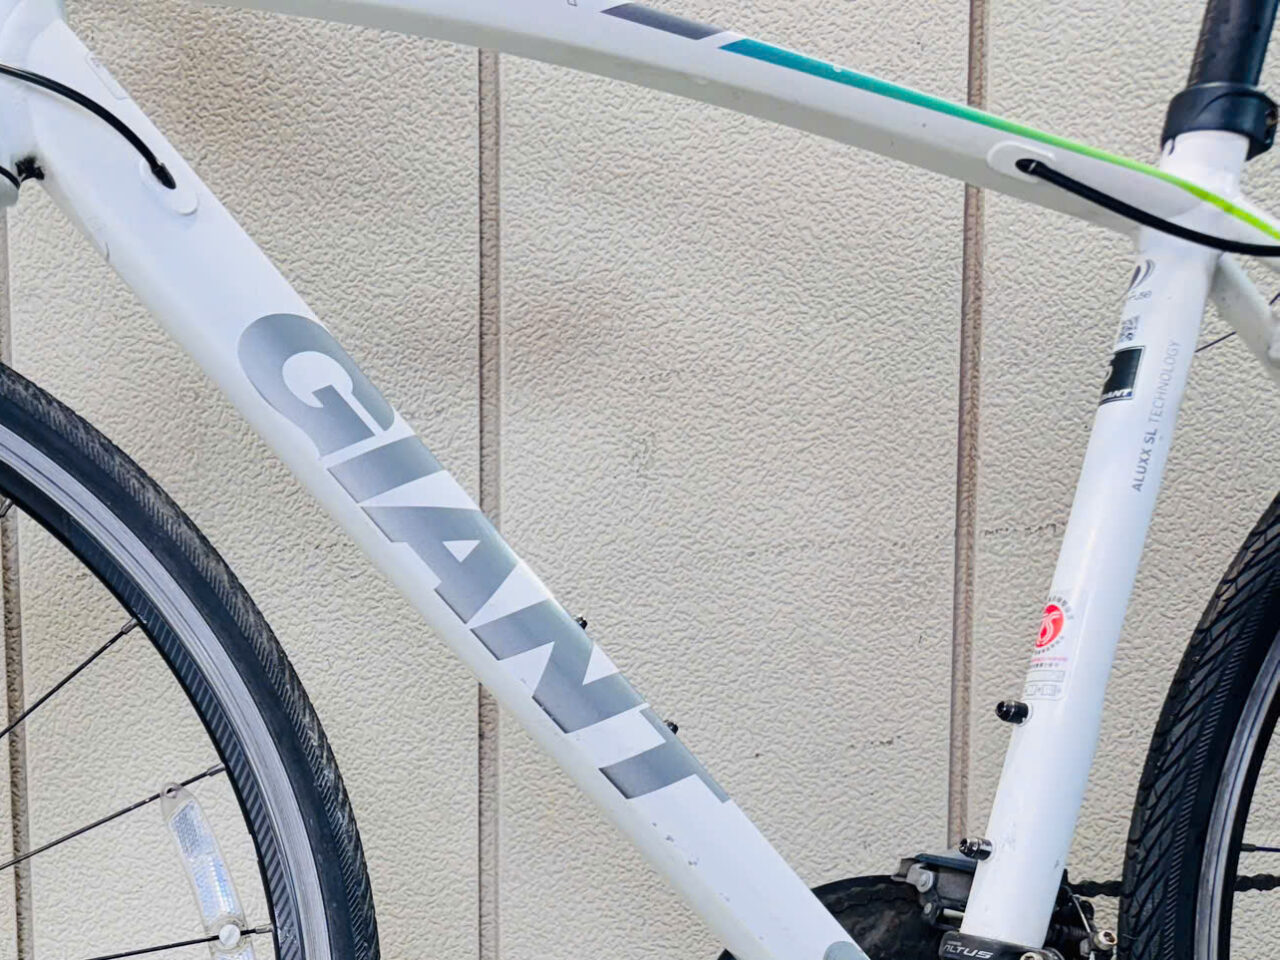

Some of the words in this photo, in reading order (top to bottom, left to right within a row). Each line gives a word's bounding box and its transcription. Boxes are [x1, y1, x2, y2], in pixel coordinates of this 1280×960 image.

[1131, 444, 1154, 492] ALUXX
[1144, 427, 1157, 447] SL
[1151, 339, 1180, 426] TECHNOLOGY
[237, 313, 730, 799] GIANT
[943, 944, 994, 959] ALTUS
